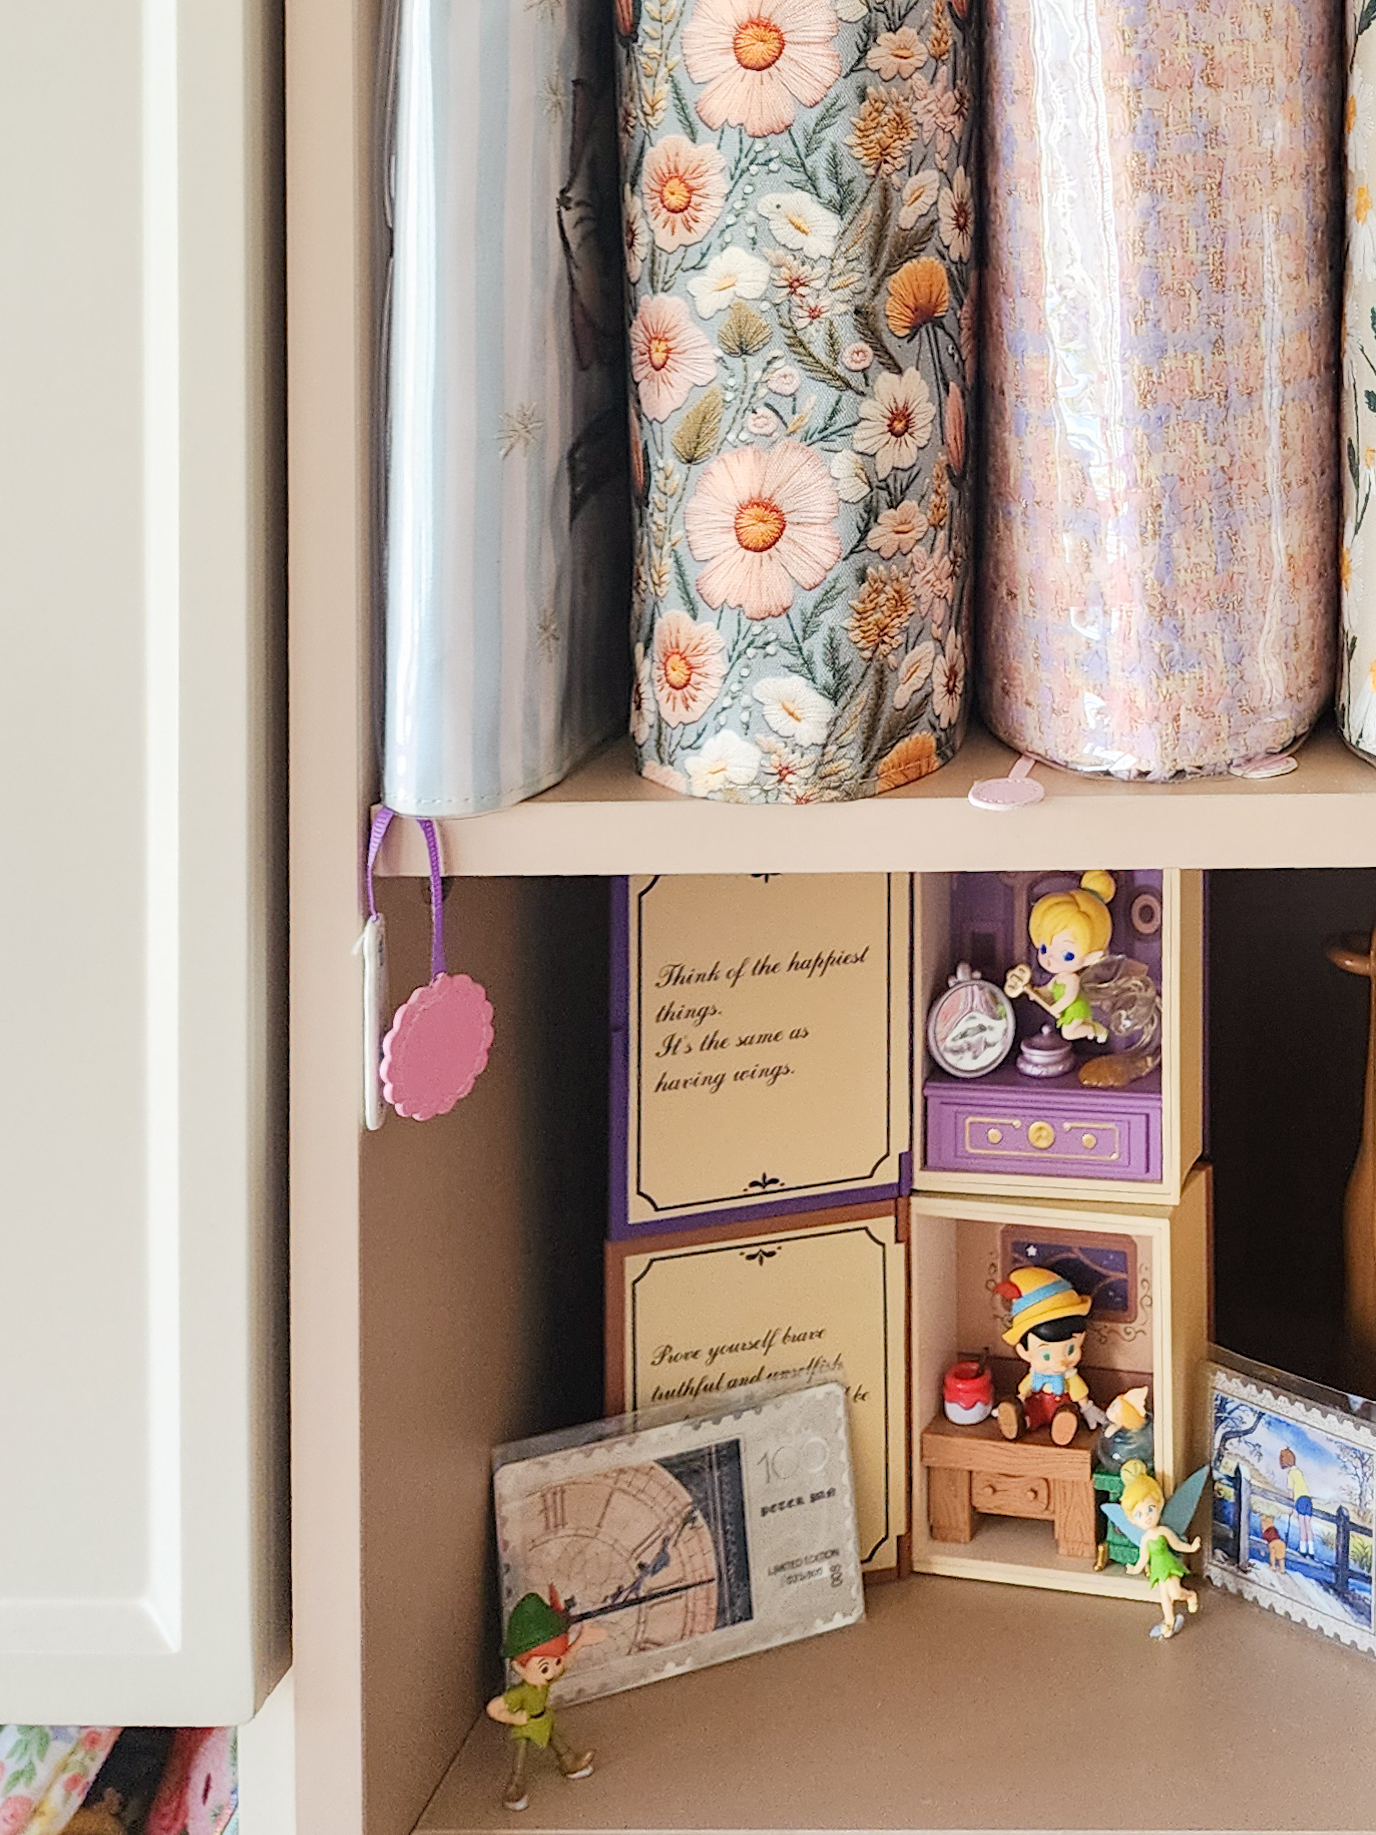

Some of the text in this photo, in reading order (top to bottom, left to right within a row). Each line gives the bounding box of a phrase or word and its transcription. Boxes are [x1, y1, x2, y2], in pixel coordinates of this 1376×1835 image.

[655, 945, 870, 989] Think of the happiest
[655, 1001, 722, 1027] things.
[655, 1025, 810, 1058] It's the same as
[654, 1063, 795, 1094] having wings.
[651, 1326, 826, 1366] Prove yourself brave
[651, 1372, 725, 1402] truthful
[727, 1366, 765, 1390] and
